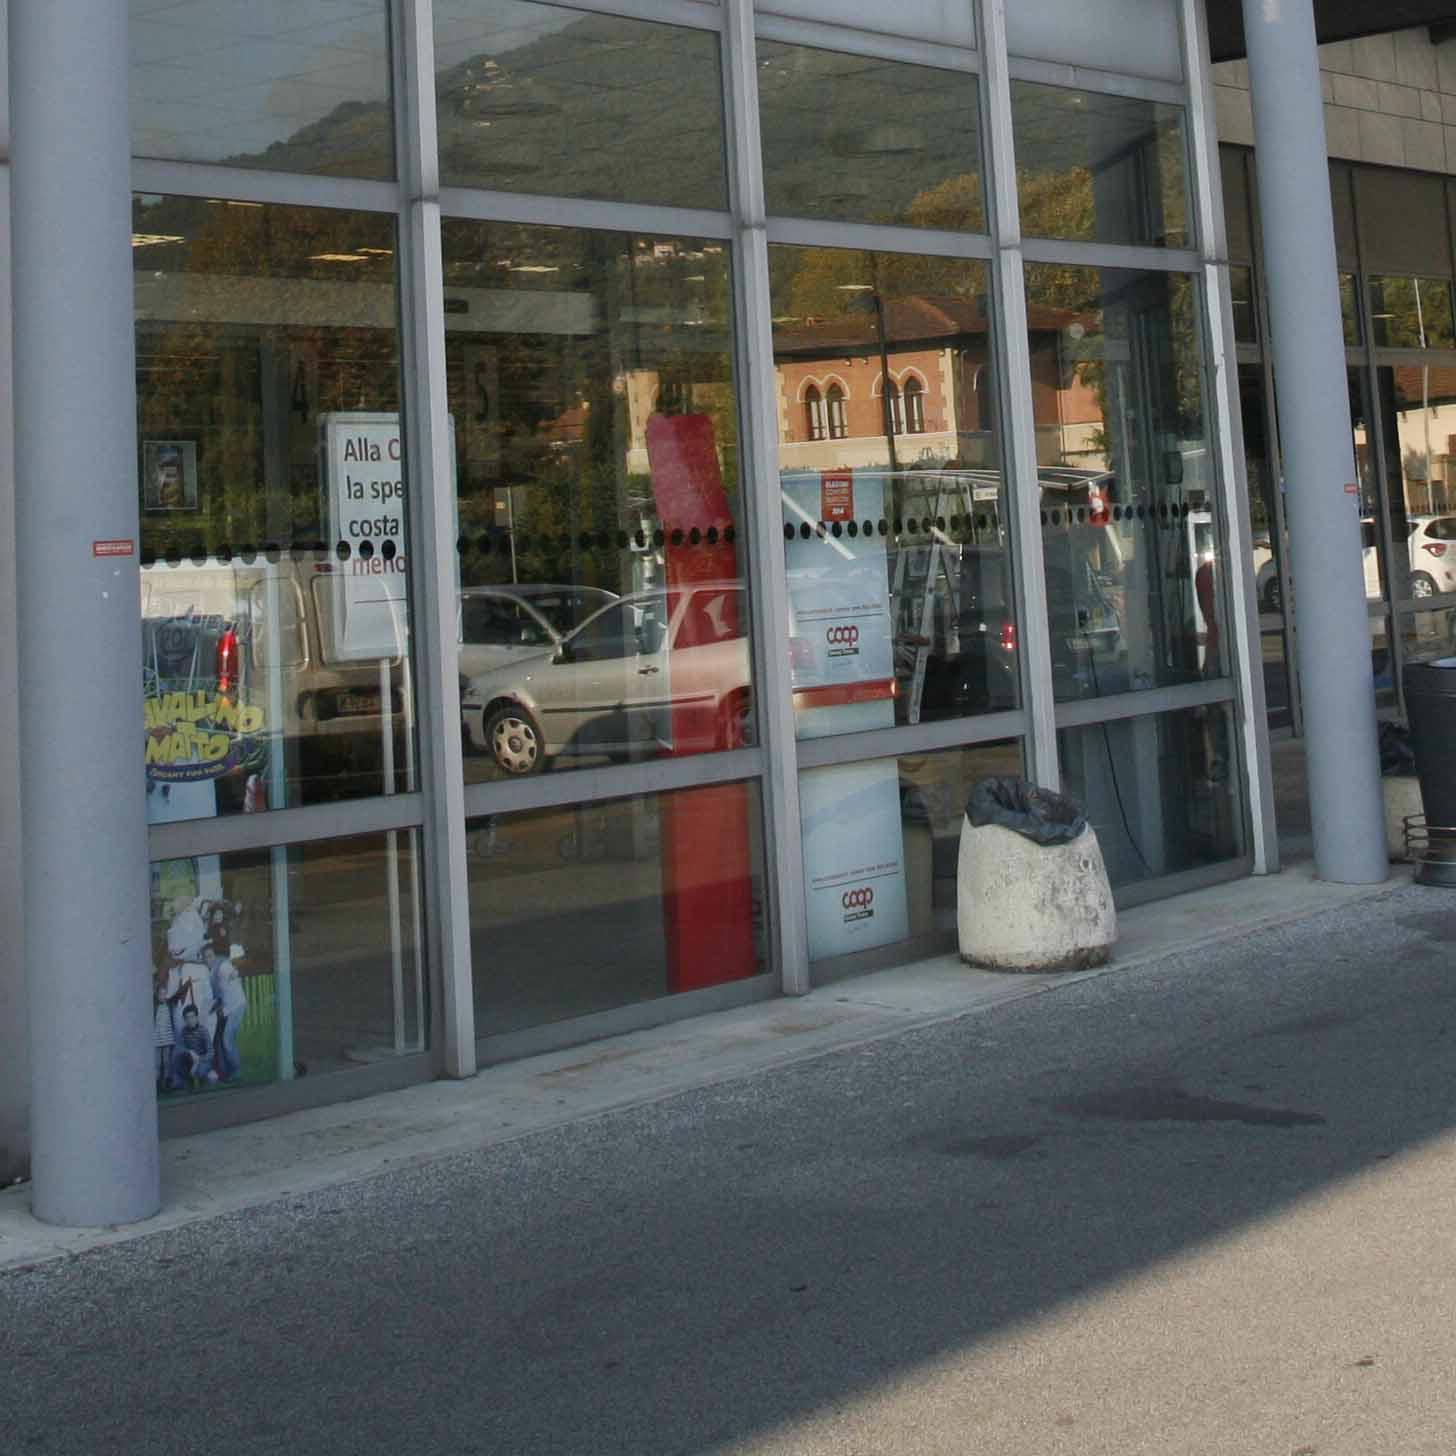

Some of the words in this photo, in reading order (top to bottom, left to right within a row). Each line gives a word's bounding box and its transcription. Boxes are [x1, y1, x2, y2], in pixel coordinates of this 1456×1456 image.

[344, 437, 382, 462] Alla
[346, 475, 364, 500] la
[349, 514, 399, 537] costa
[827, 625, 860, 647] coop
[842, 887, 874, 910] coop
